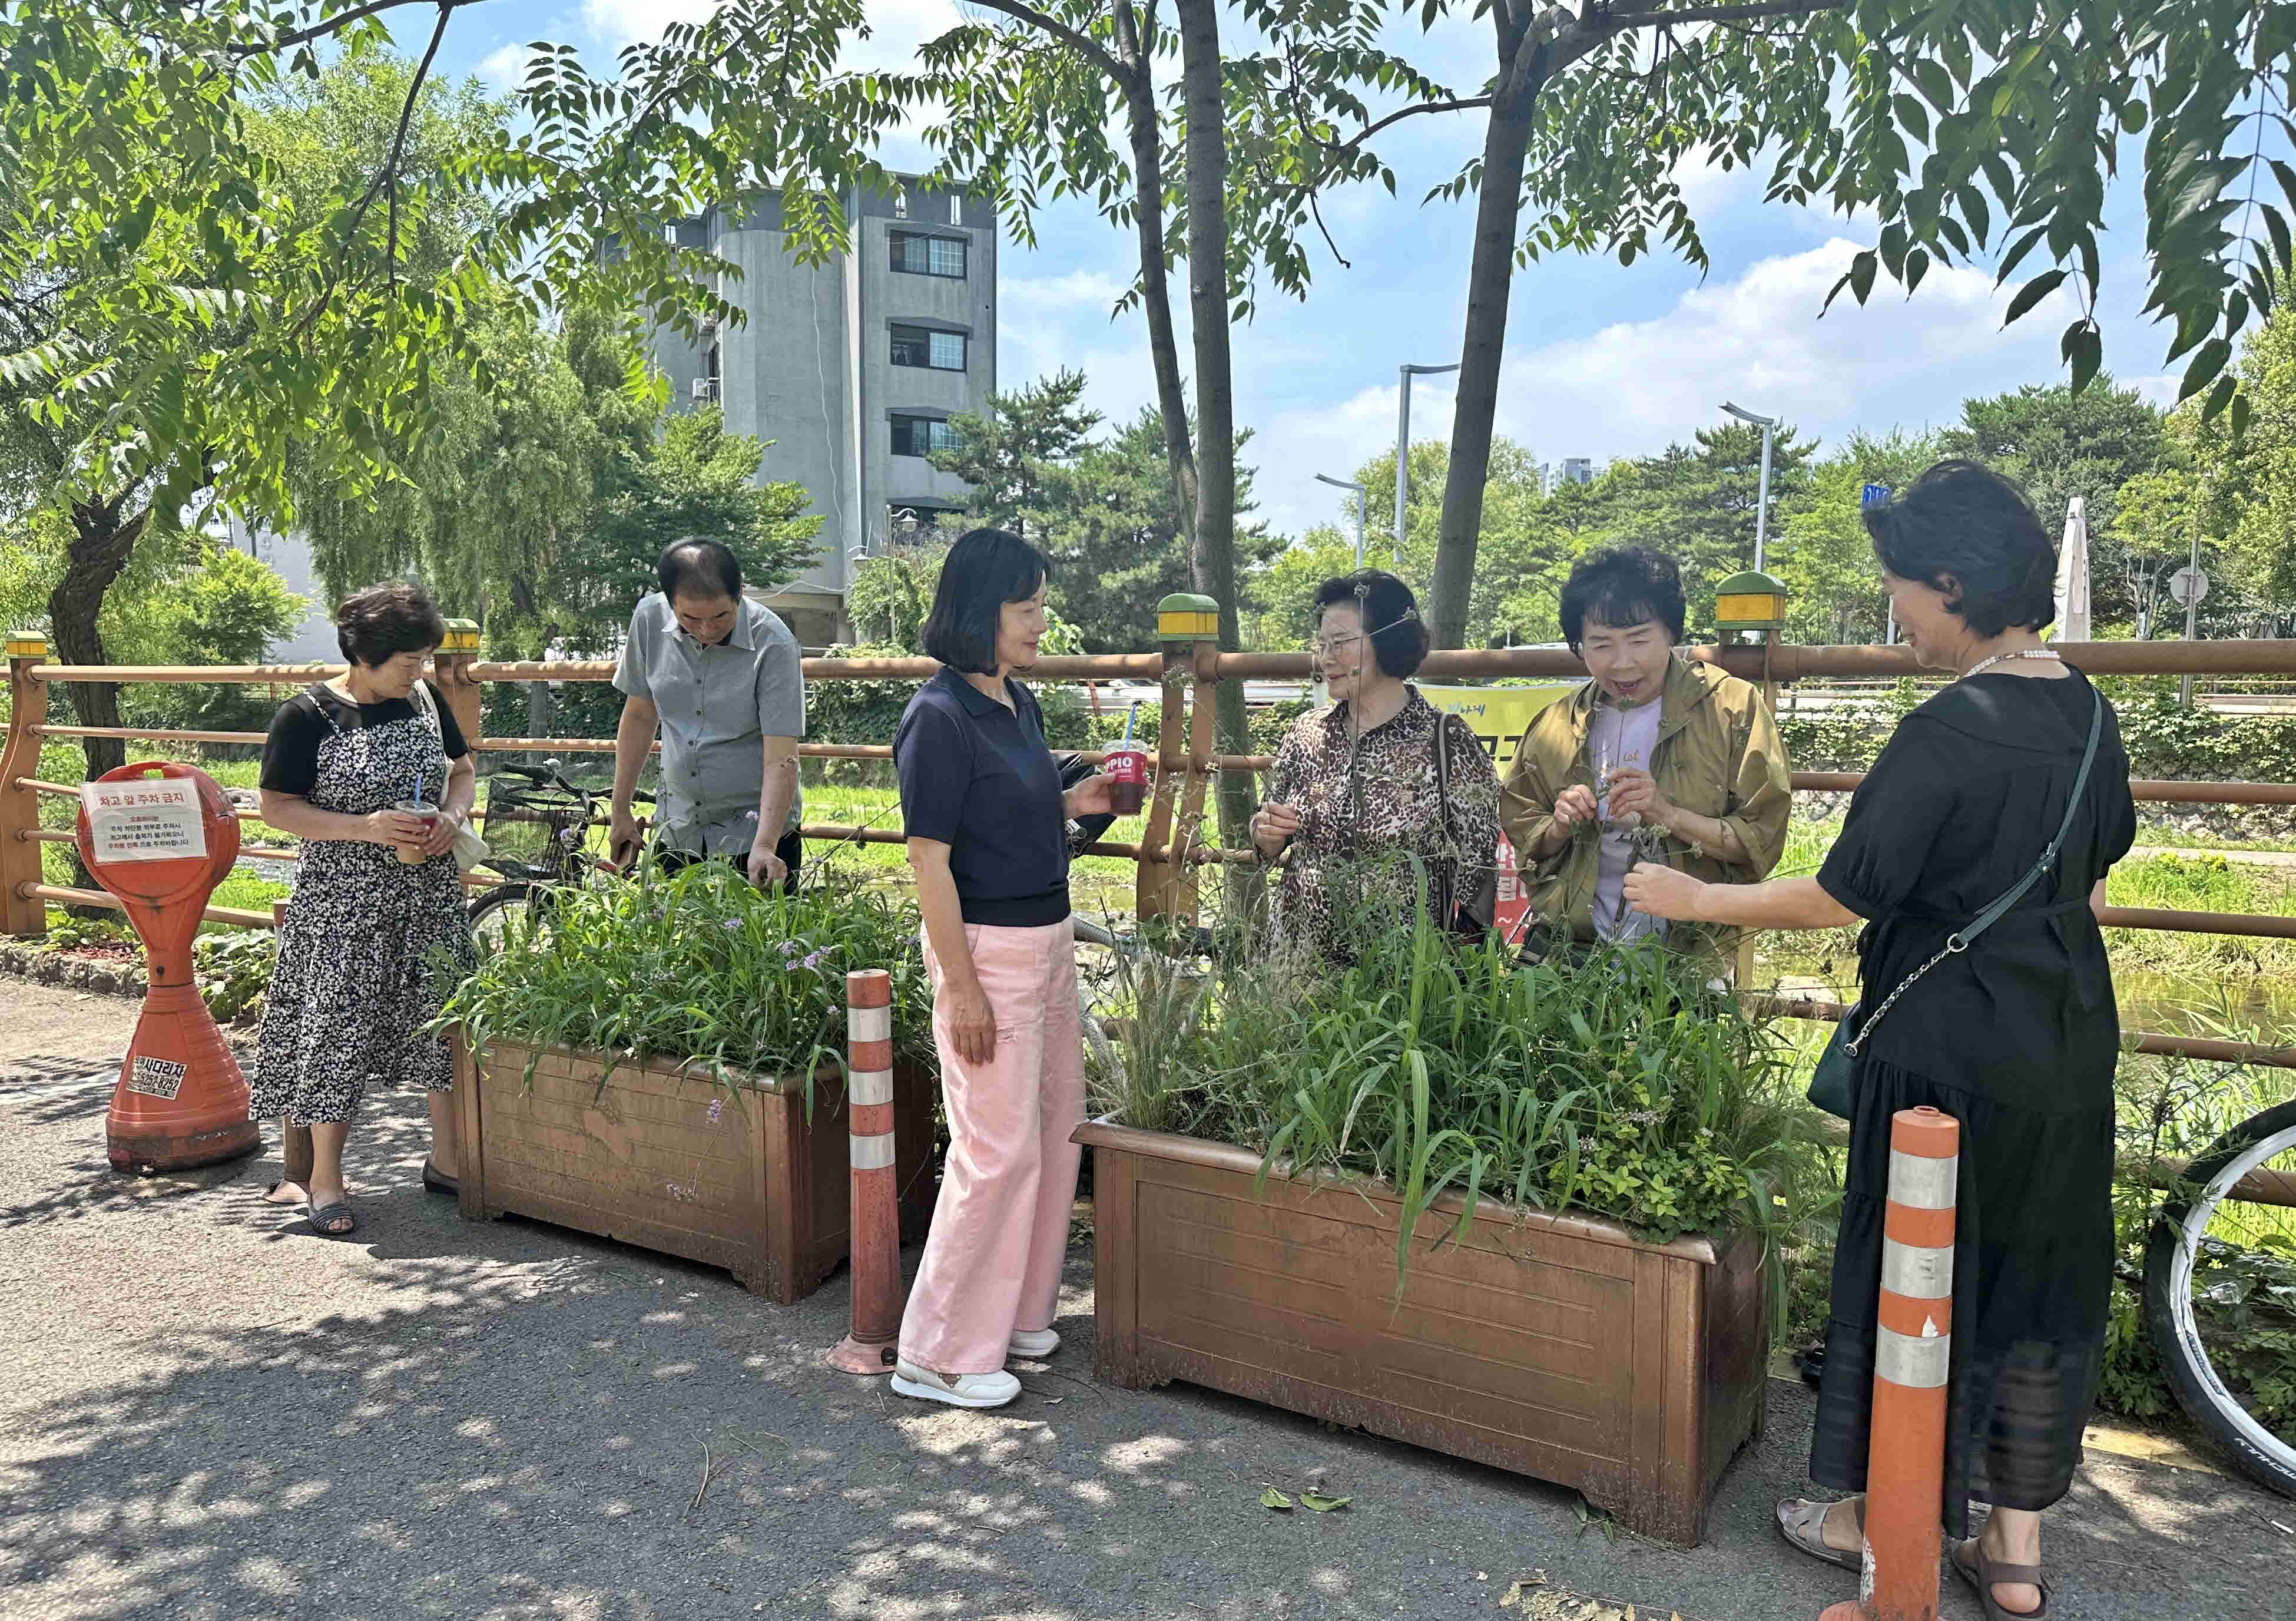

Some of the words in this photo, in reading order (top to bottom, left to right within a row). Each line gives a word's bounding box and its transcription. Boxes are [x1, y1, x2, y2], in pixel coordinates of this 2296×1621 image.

[99, 796, 122, 806] 차고
[124, 795, 134, 805] 앞
[138, 793, 160, 805] 주차
[161, 792, 184, 803] 금지
[145, 1058, 184, 1077] 사다리차
